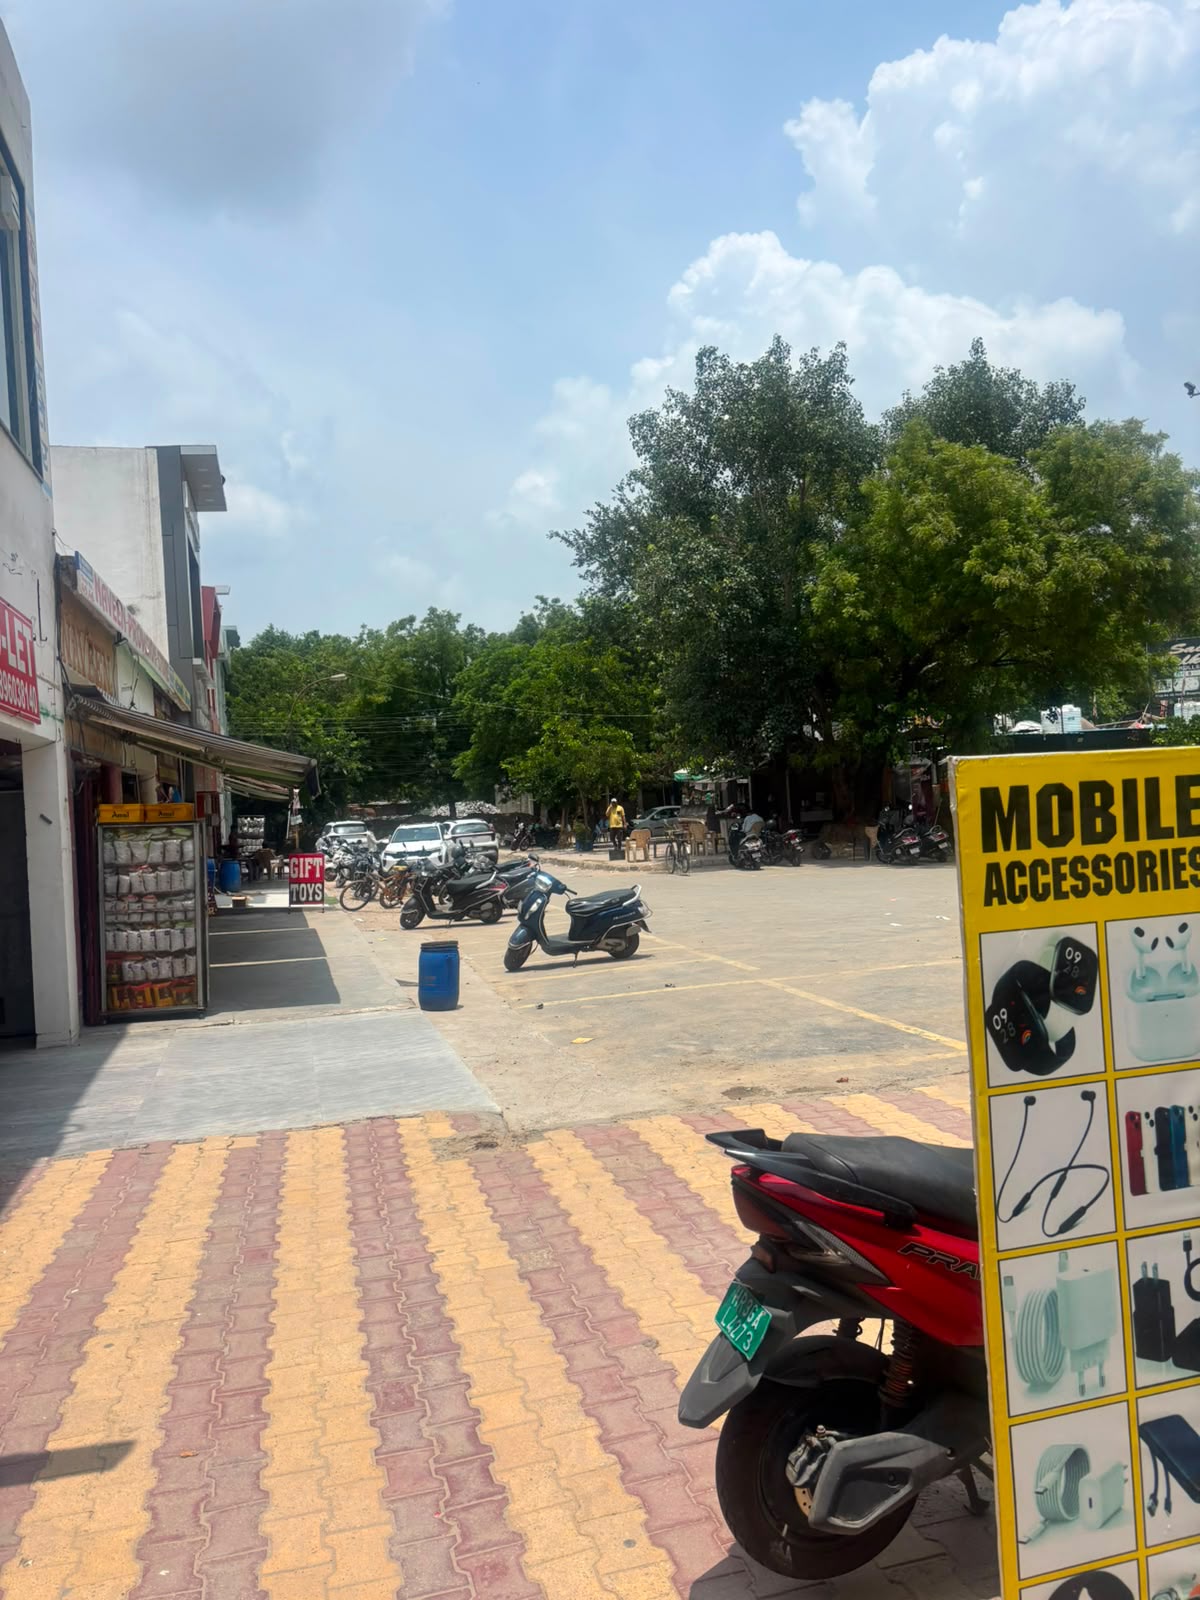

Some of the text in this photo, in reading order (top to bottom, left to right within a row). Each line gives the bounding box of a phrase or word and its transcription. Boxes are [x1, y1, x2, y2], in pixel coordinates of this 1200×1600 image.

[0, 610, 33, 677] -LET
[980, 774, 1200, 853] MOBILE
[290, 858, 323, 879] GIFT
[290, 883, 323, 902] TOYS
[1065, 947, 1082, 963] 09
[992, 1008, 1008, 1030] 09
[897, 1241, 979, 1280] PRA
[721, 1306, 753, 1351] L4273
